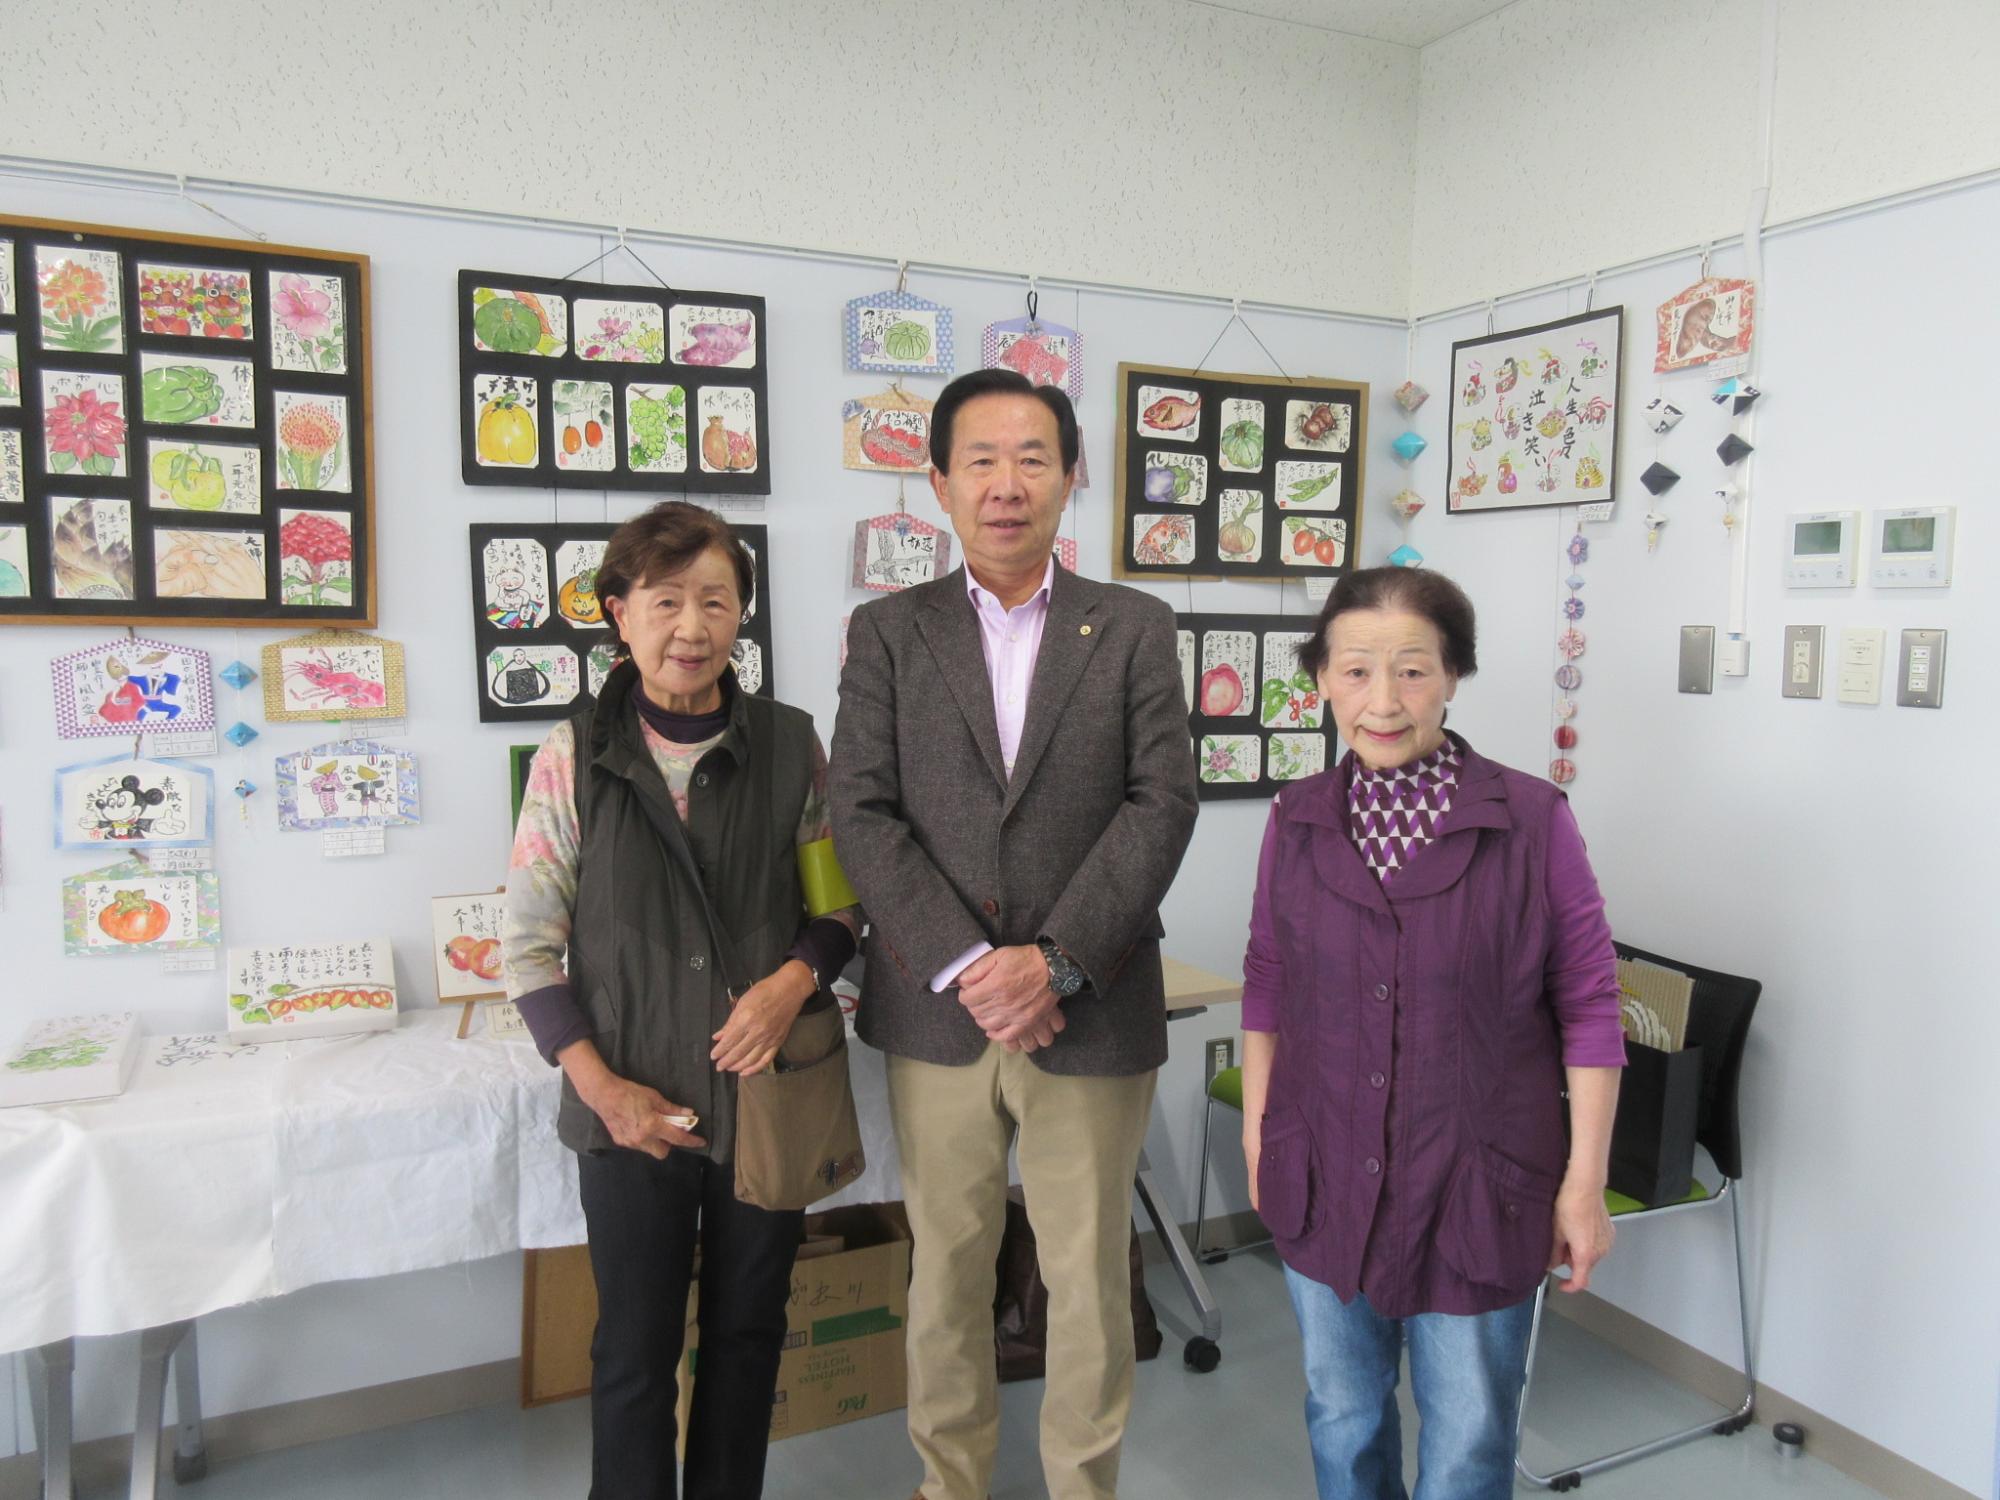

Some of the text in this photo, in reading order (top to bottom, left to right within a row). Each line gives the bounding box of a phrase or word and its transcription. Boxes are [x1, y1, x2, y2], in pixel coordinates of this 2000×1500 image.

[1521, 389, 1547, 468] 泣き笑い
[1559, 376, 1582, 460] 人生色々
[160, 776, 183, 812] 素敵な
[798, 1364, 856, 1384] HAPPINESS
[804, 1354, 850, 1372] HOTEL
[836, 1392, 868, 1416] P&G
